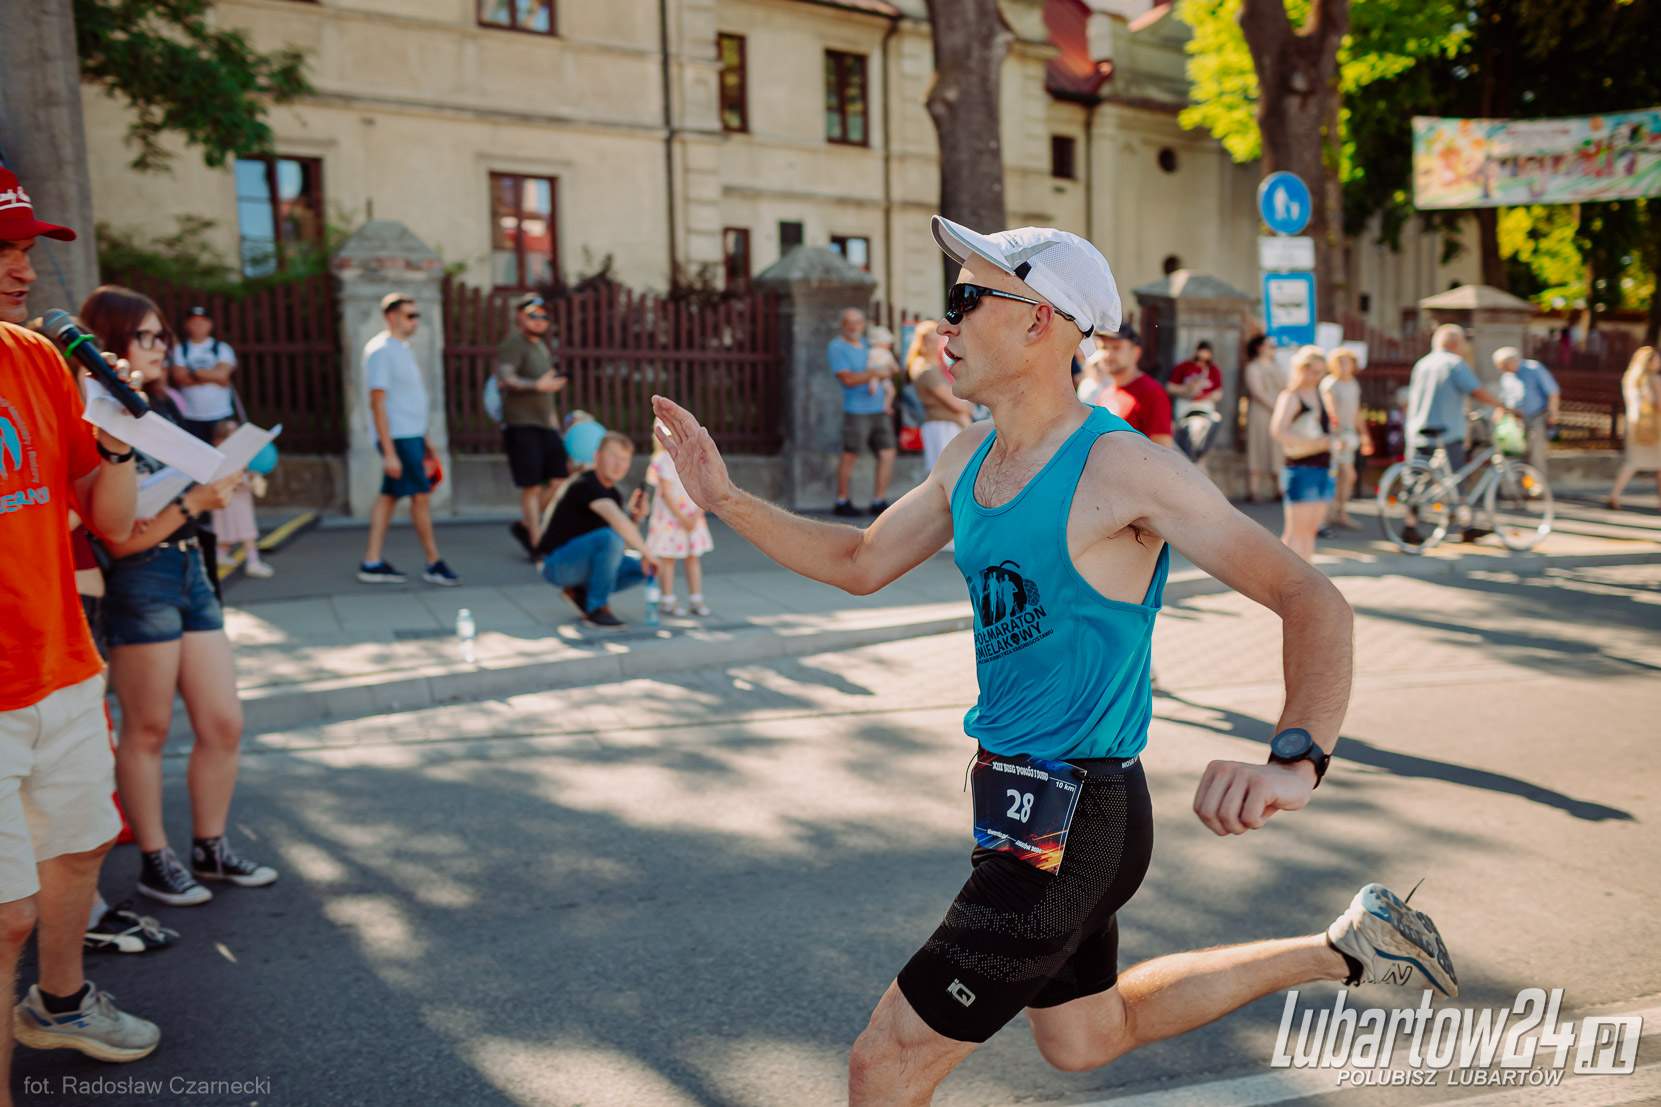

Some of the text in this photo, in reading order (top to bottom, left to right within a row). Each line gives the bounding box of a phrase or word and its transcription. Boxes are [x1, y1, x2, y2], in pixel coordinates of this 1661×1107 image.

[1055, 781, 1075, 792] 10 km
[1006, 788, 1035, 824] 28
